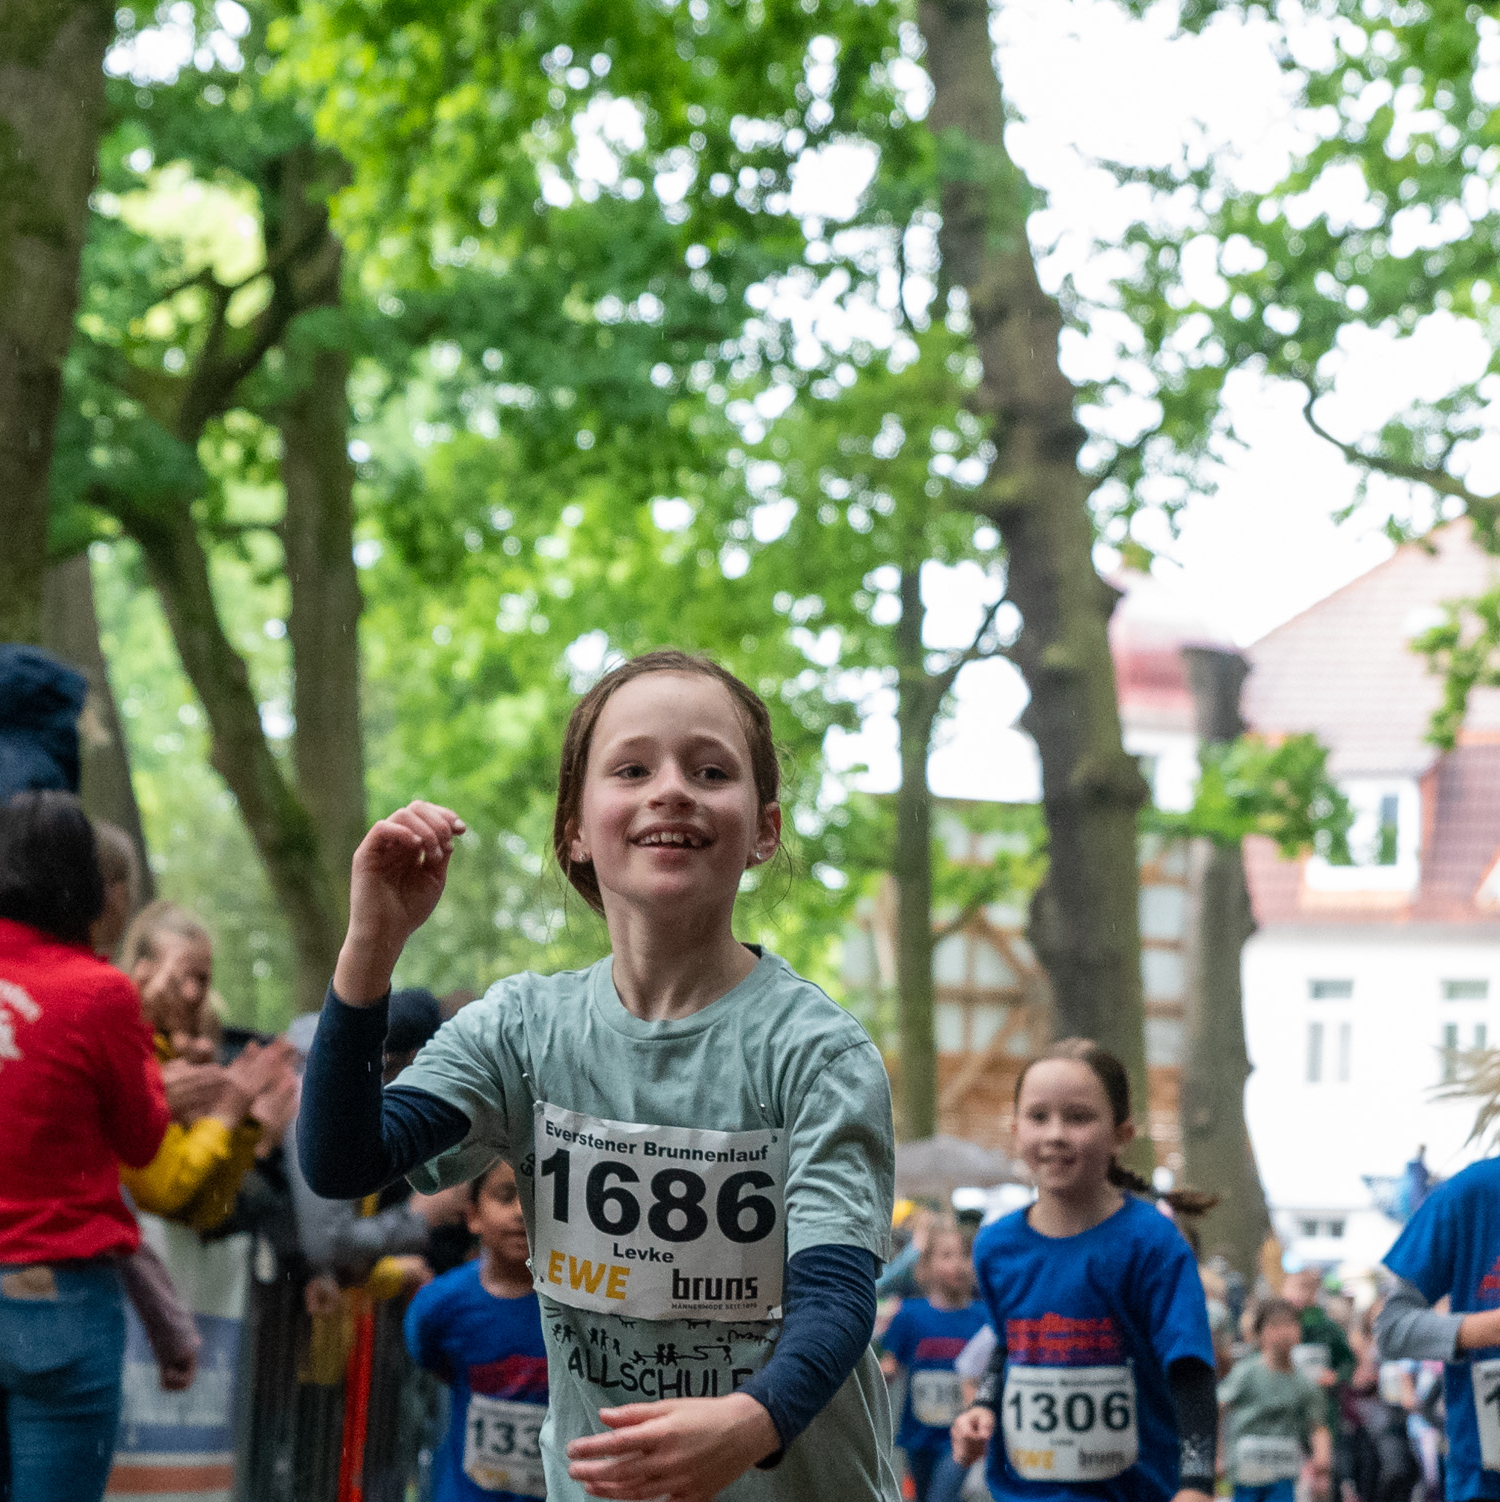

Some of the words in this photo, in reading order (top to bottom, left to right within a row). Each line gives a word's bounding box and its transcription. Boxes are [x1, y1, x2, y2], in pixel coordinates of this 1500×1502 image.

[545, 1119, 637, 1154] Everstener
[643, 1141, 768, 1163] Brunnenlauf
[541, 1147, 777, 1244] 1686
[548, 1249, 630, 1300] EWE
[613, 1242, 674, 1264] Levke
[672, 1268, 758, 1300] bruns
[1009, 1390, 1130, 1433] 1306
